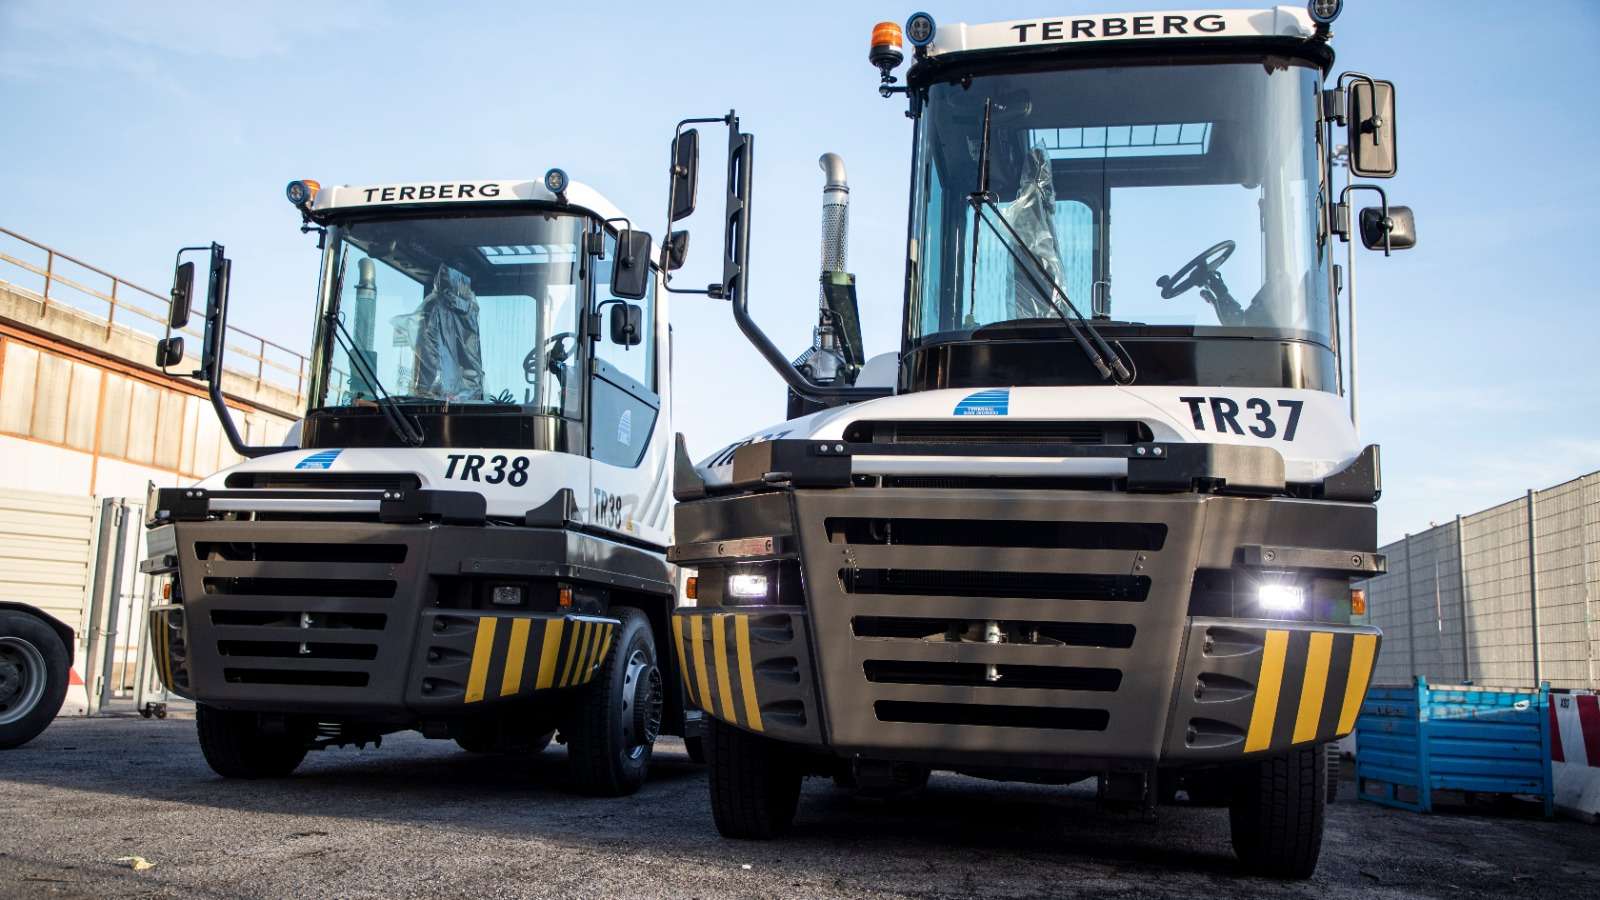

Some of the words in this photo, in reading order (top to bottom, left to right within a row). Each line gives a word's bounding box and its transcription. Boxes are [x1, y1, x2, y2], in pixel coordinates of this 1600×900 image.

[1010, 14, 1226, 43] TERBERG
[363, 184, 500, 202] TERBERG
[1179, 396, 1304, 441] TR37
[445, 454, 530, 487] TR38
[594, 488, 622, 529] TR38
